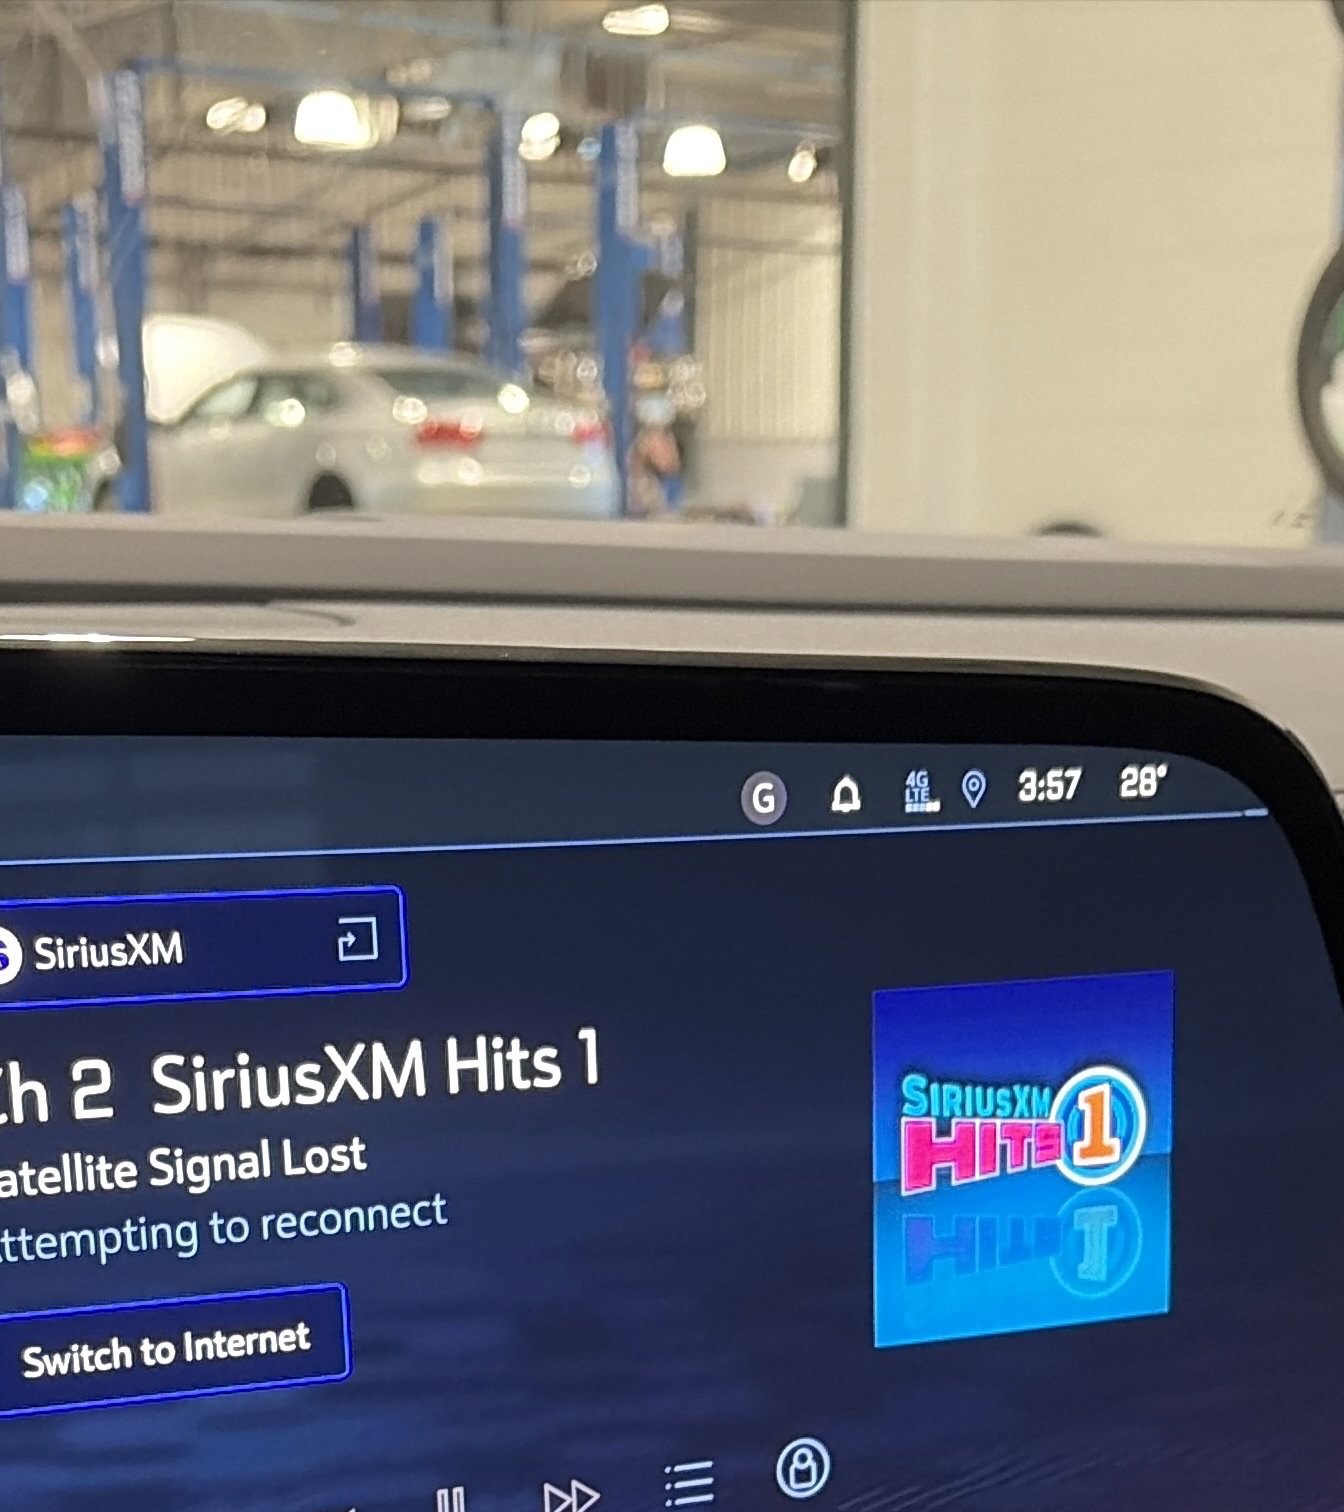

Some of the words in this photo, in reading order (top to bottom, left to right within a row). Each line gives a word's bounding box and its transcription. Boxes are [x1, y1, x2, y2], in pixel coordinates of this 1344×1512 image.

[752, 782, 775, 814] G
[906, 769, 929, 787] 4G
[906, 787, 930, 802] LTE
[1018, 767, 1082, 802] 3:57
[1120, 763, 1168, 798] 28°
[33, 931, 184, 973] SiriusXM
[72, 1058, 115, 1120] 2
[152, 1039, 427, 1116] SiriusXM
[445, 1035, 562, 1096] Hits
[577, 1027, 600, 1085] 1
[901, 1117, 1065, 1197] HITS
[1072, 1082, 1121, 1166] 1
[148, 1138, 271, 1193] Signal
[282, 1136, 368, 1176] Lost
[209, 1210, 250, 1246] to
[260, 1193, 448, 1241] reconnect
[22, 1336, 133, 1379] Switch
[140, 1335, 176, 1367] to
[183, 1321, 312, 1364] Internet
